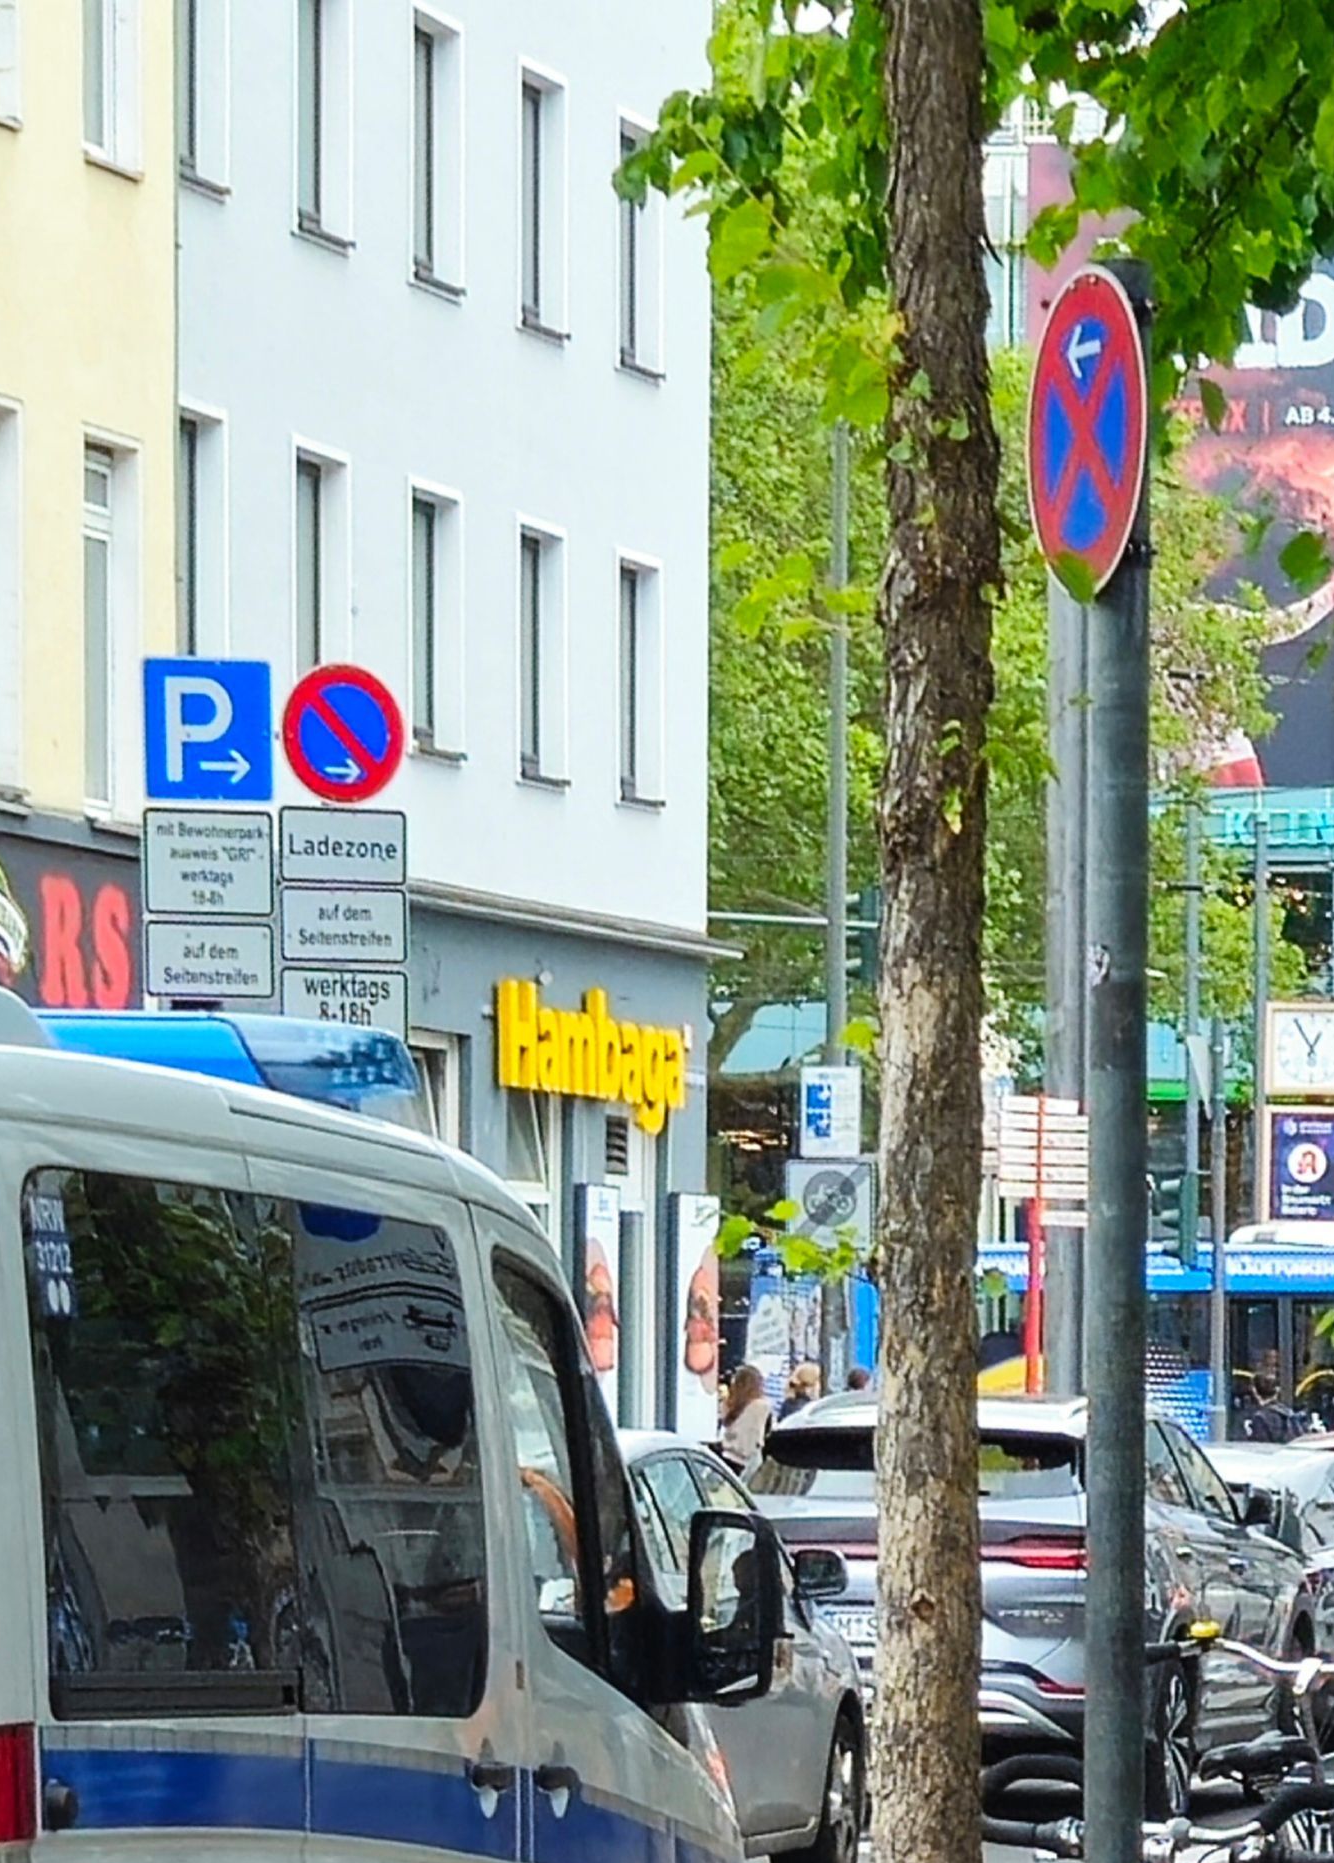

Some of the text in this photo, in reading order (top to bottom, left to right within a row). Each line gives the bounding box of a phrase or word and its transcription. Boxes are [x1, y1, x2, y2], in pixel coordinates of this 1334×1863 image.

[1285, 406, 1316, 426] AB
[164, 676, 234, 783] P
[288, 833, 398, 860] Ladezone
[318, 903, 372, 922] auf dem
[298, 928, 392, 947] Seitenstreifen
[183, 942, 239, 960] auf dem
[163, 966, 259, 985] Seitenstreifen
[304, 973, 391, 1005] werktags
[497, 974, 685, 1136] Hambaga
